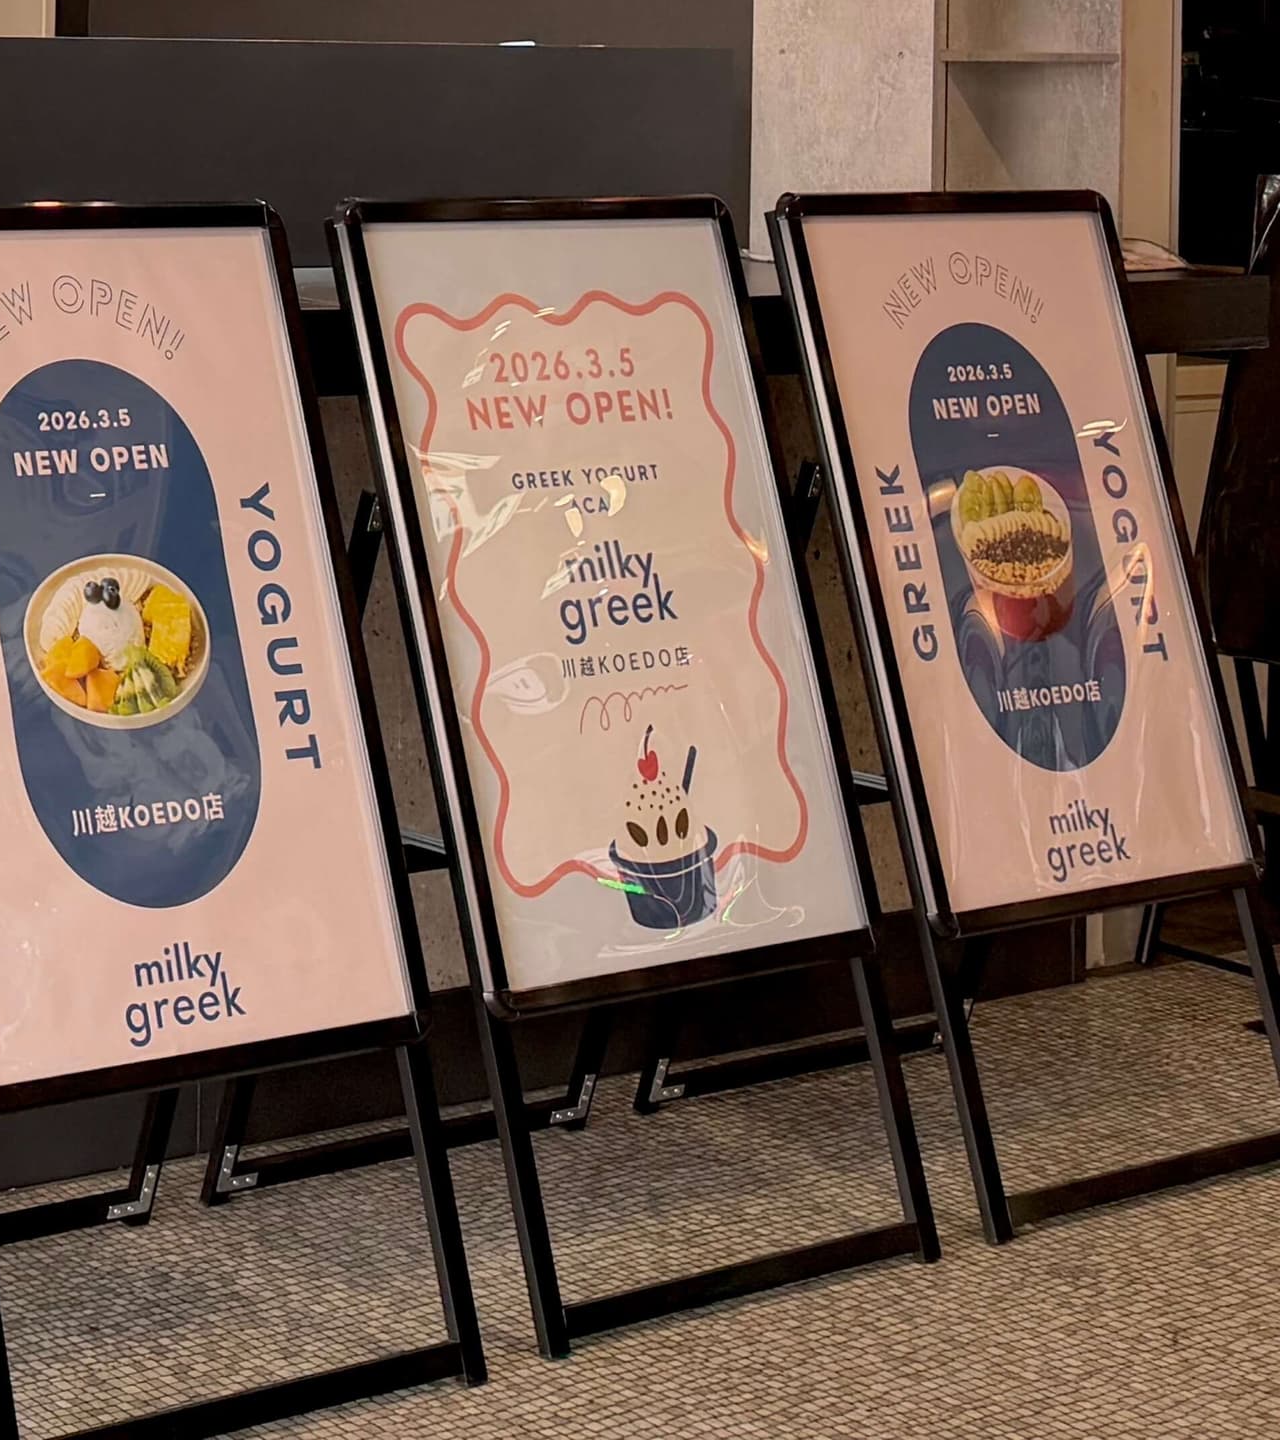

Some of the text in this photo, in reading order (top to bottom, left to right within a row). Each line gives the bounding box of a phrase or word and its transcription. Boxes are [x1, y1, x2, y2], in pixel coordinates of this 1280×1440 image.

[882, 251, 1044, 331] NEW OPEN!
[52, 274, 185, 361] OPEN!
[490, 347, 635, 383] 2026.3.5
[947, 363, 1013, 383] 2026.3.5
[36, 408, 132, 432] 2026.3.5
[466, 388, 673, 431] NEW OPEN!
[932, 392, 1041, 420] NEW OPEN
[13, 443, 169, 477] NEW OPEN
[511, 464, 659, 490] GREEK YOGURT
[569, 495, 616, 514] ACA
[564, 539, 653, 588] milky
[875, 463, 939, 662] GREEK
[1092, 428, 1169, 662] YOGURT
[239, 481, 322, 770] YOGURT
[559, 572, 679, 645] greek
[561, 646, 690, 679] 川越KOEDO店
[997, 678, 1102, 712] 川越KOEDO店
[72, 791, 225, 837] 川越KOEDO店
[1049, 799, 1110, 836] milky
[1047, 823, 1131, 882] greek
[134, 941, 222, 987] milky
[125, 971, 247, 1047] greek
